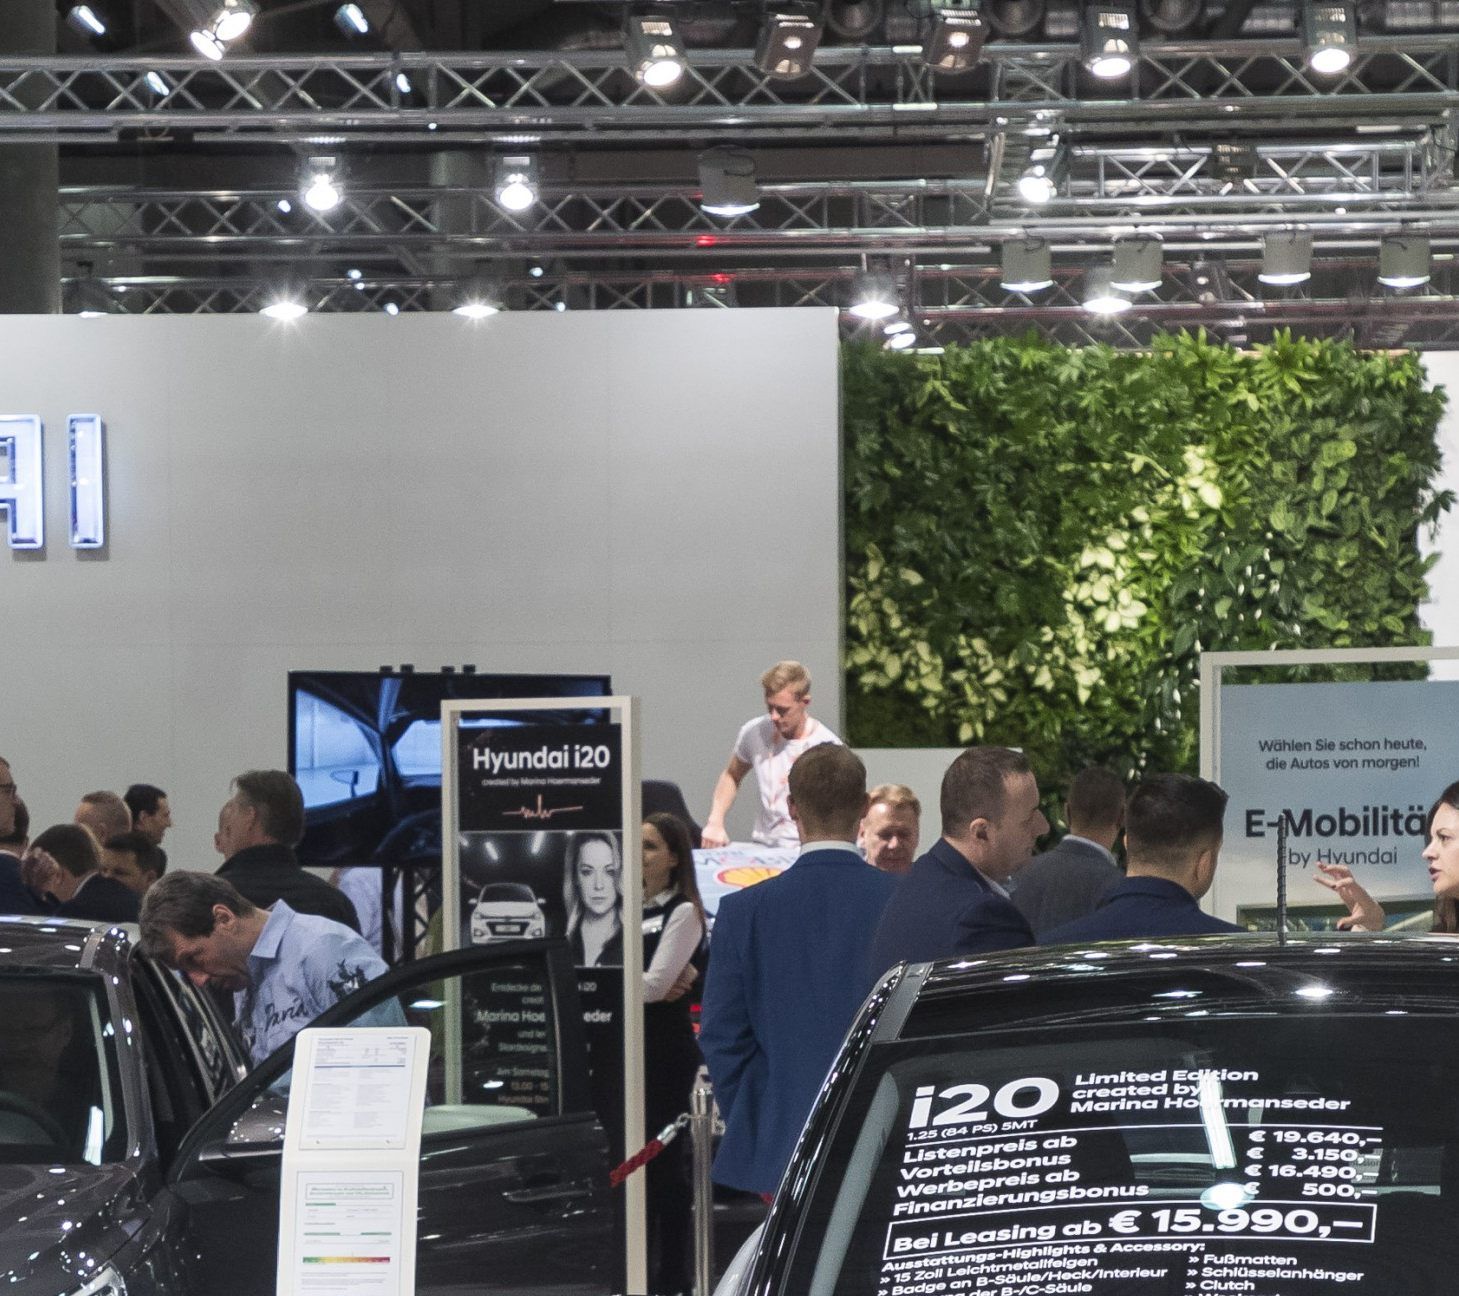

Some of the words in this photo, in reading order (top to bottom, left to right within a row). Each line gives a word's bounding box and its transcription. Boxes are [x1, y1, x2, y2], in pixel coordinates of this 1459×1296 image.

[1258, 738, 1312, 752] Wählen
[1315, 738, 1336, 751] Sie
[1339, 738, 1381, 751] schon
[1384, 738, 1427, 751] heute,
[473, 744, 569, 774] Hyundai
[574, 744, 611, 768] i20
[1266, 757, 1287, 770] die
[1290, 757, 1330, 769] Autos
[1333, 758, 1359, 769] von
[1362, 756, 1420, 771] morgen!
[1245, 805, 1427, 838] E-Mobilitä
[1288, 848, 1311, 868] by
[1317, 846, 1398, 866] Hyundai
[1075, 1069, 1166, 1086] Limited
[1173, 1068, 1260, 1082] Edition
[1072, 1083, 1168, 1100] created
[1173, 1083, 1201, 1098] by
[909, 1077, 1060, 1129] i20
[1070, 1098, 1159, 1113] Marina
[1164, 1097, 1352, 1111] Homanseder
[907, 1130, 938, 1141] 1.25
[941, 1126, 968, 1138] (84
[972, 1123, 998, 1134] PS)
[1001, 1119, 1039, 1131] 5MT
[1249, 1130, 1266, 1143] €
[903, 1137, 1038, 1164] Listenpreis
[1042, 1135, 1078, 1149] ab
[1246, 1147, 1264, 1160] €
[900, 1153, 1072, 1180] Vorteilsbonus
[1244, 1164, 1262, 1177] €
[896, 1172, 1040, 1198] Werbepreis
[1045, 1169, 1080, 1183] ab
[893, 1184, 1149, 1216] Finanzierungsbonus
[893, 1233, 938, 1253] Bei
[943, 1223, 1056, 1247] Leasing
[1062, 1220, 1102, 1237] ab
[1108, 1209, 1142, 1234] €
[881, 1244, 1091, 1273] Ausstattungs-Highlights
[1093, 1243, 1108, 1254] &
[1109, 1242, 1206, 1253] Accessory:
[1203, 1253, 1297, 1266] Fußmatten
[891, 1282, 947, 1296] Badge
[950, 1279, 972, 1289] an
[976, 1267, 1168, 1288] B-Säule/Heck/Interieur
[894, 1273, 911, 1284] 15
[914, 1269, 943, 1281] Zoll
[947, 1257, 1098, 1277] Leichtmetallfelgen
[1201, 1266, 1364, 1282] Schlüsselanhänger
[1001, 1281, 1093, 1296] B-/C-Säule
[1199, 1279, 1255, 1291] Clutch
